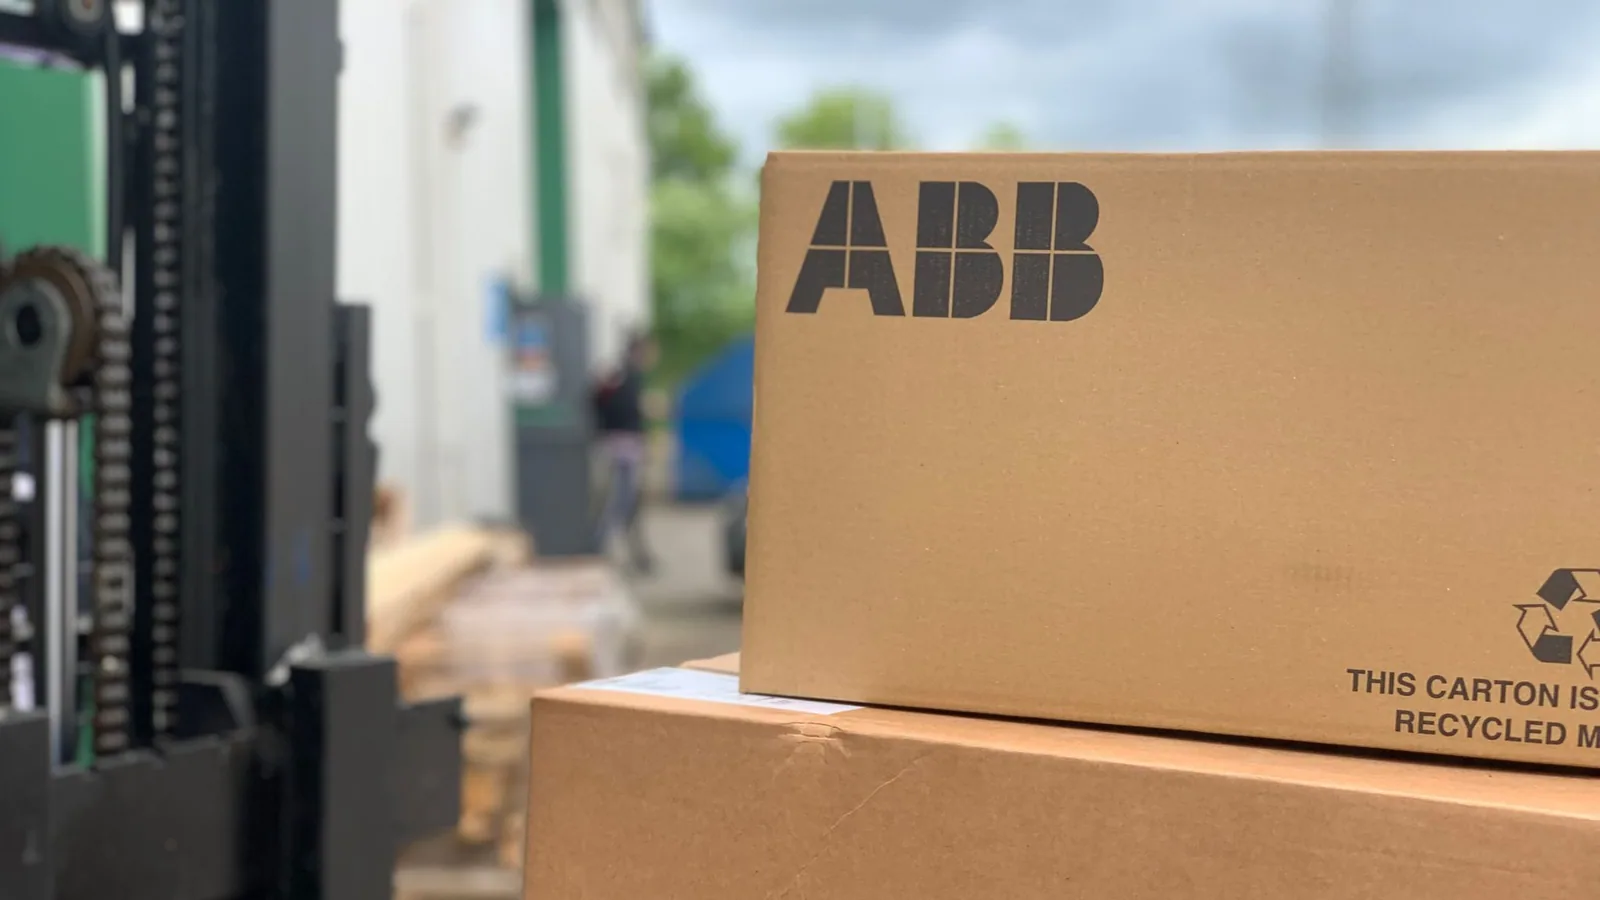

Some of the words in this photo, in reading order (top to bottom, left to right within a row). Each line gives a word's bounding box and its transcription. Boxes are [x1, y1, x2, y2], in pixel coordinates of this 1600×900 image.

[785, 180, 1104, 322] ABB
[1347, 668, 1416, 697] THIS
[1426, 674, 1559, 708] CARTON
[1570, 685, 1600, 711] IS
[1395, 709, 1567, 745] RECYCLED
